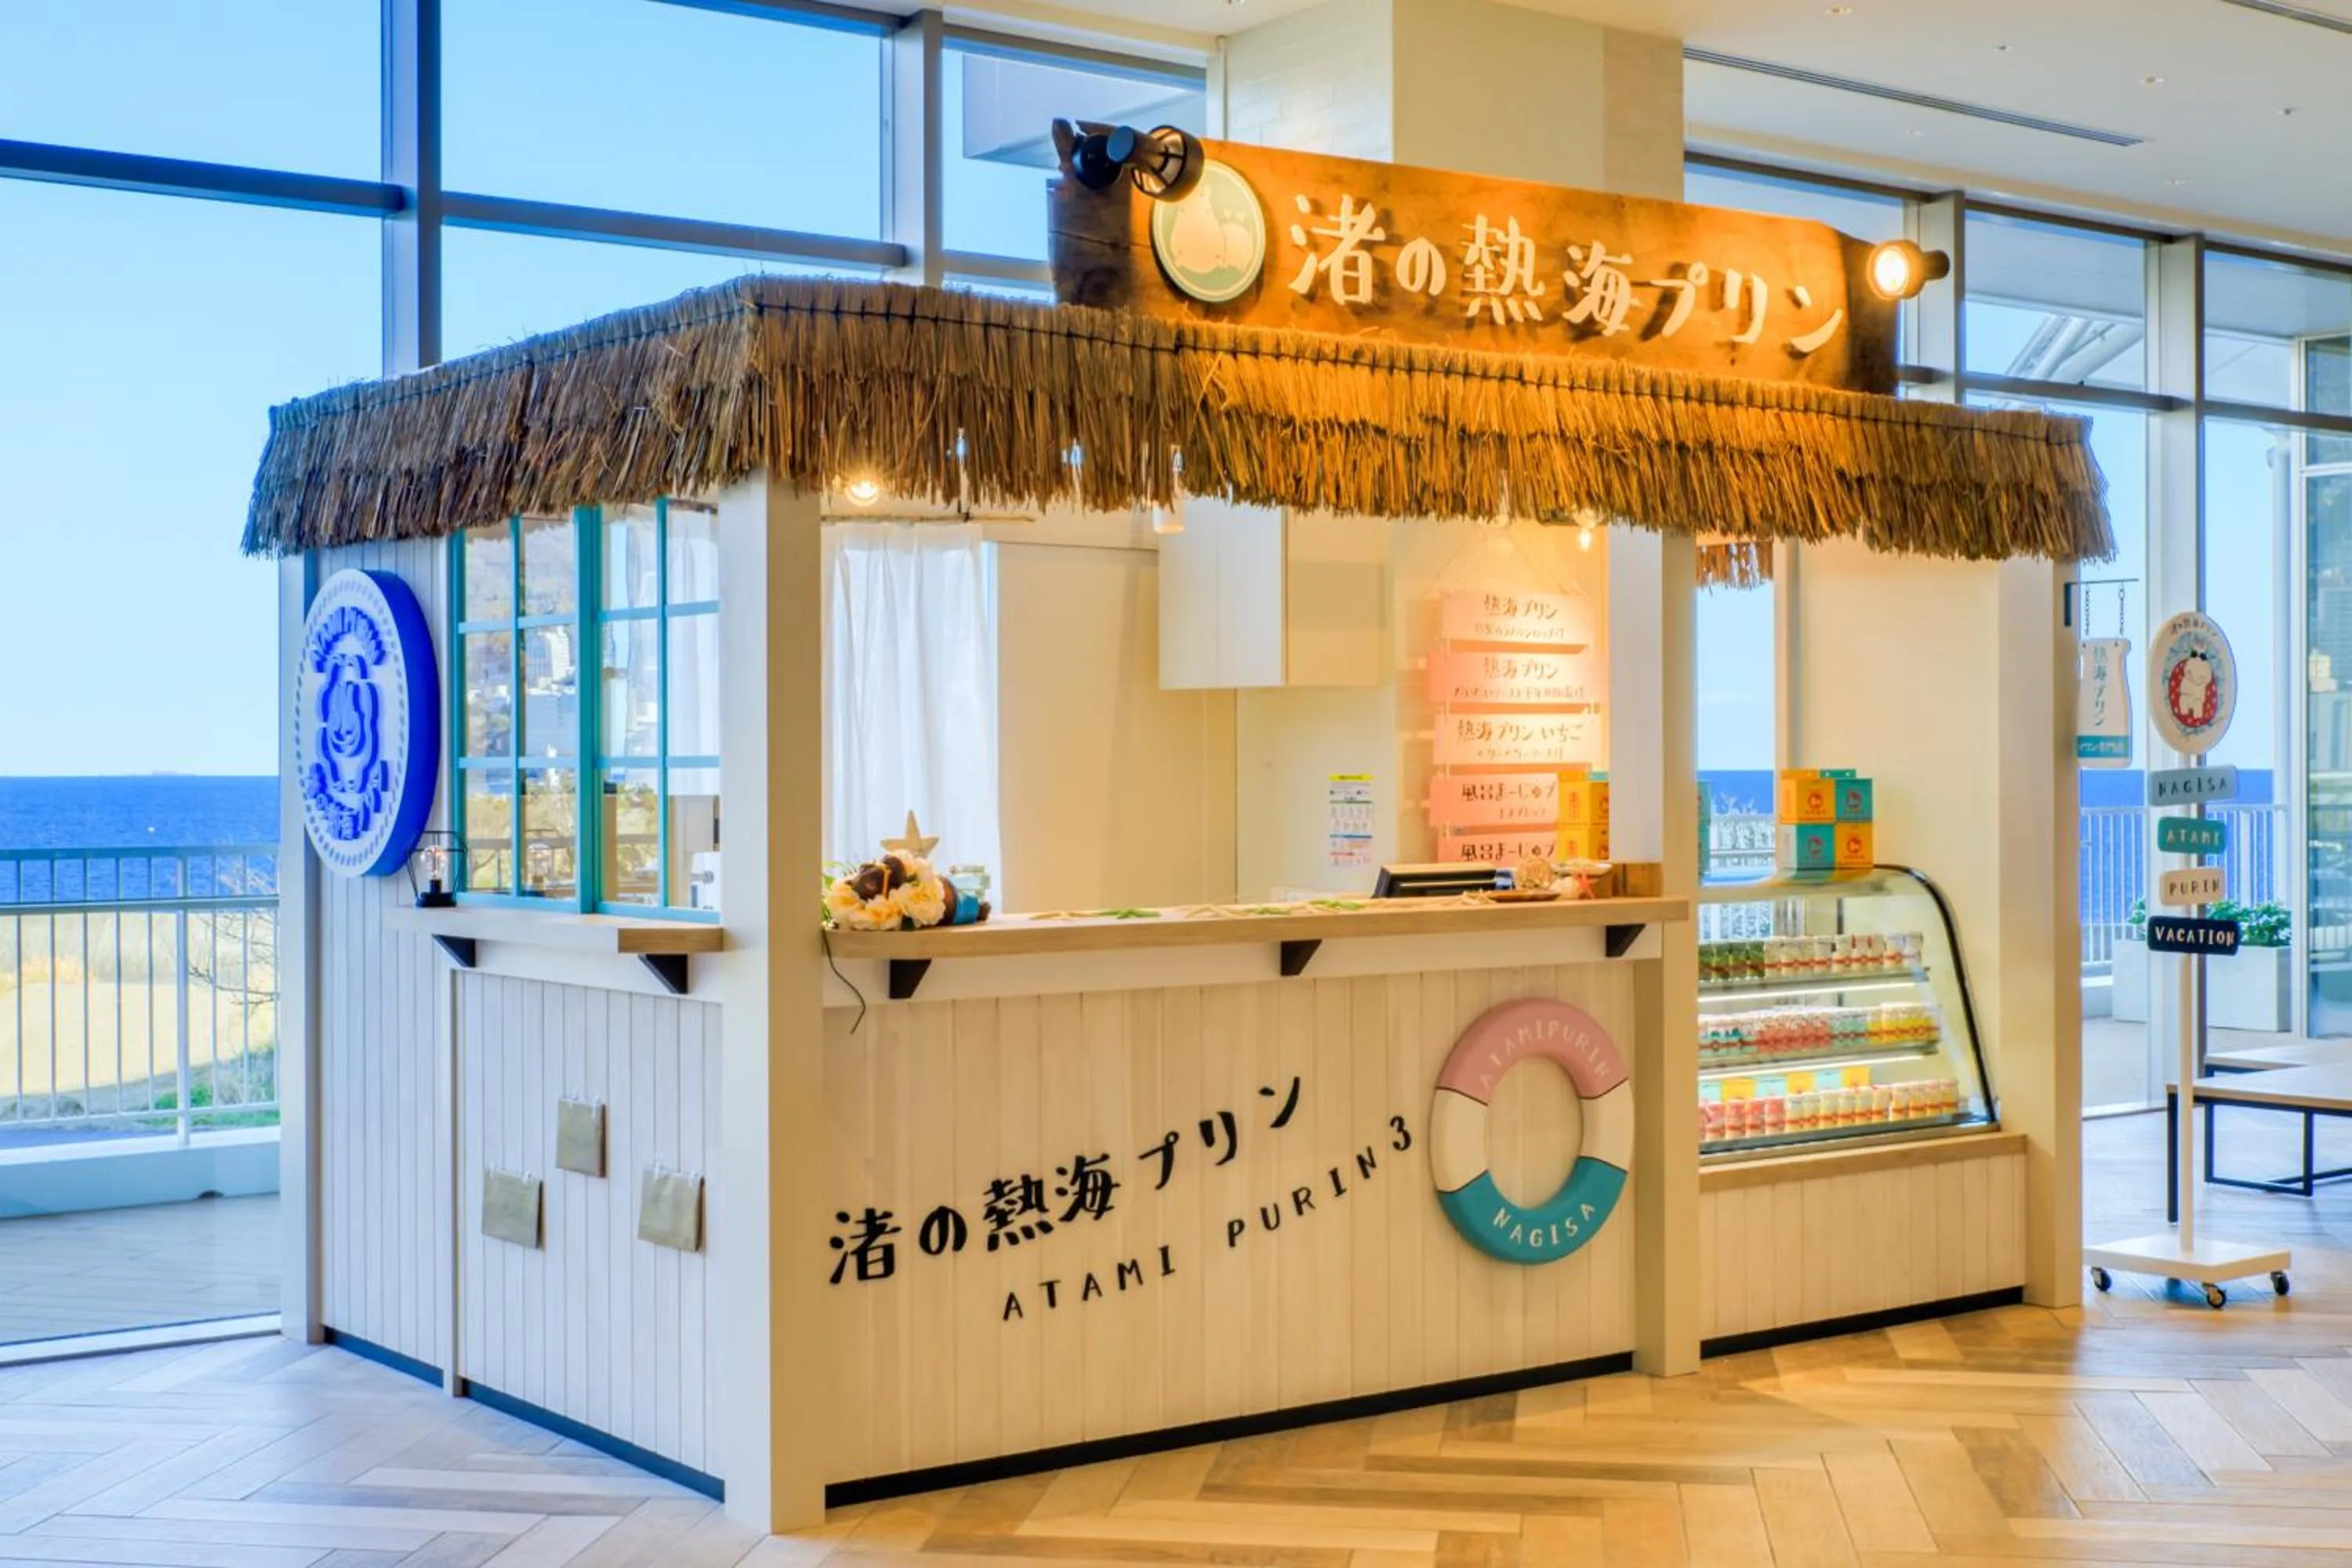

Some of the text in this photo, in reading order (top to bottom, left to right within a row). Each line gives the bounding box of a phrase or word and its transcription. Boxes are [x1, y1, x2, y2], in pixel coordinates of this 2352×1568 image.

[1288, 193, 1842, 354] 渚の熱海プリン
[2158, 776, 2227, 798] NAGISA
[2166, 828, 2220, 845] ATAMI
[2169, 877, 2220, 897] PURIN
[2155, 926, 2235, 947] VACATION
[1480, 1019, 1611, 1091] ATAMIPURIN
[829, 1076, 1301, 1285] 渚の熱海プリン
[1493, 1203, 1595, 1247] NAGISA
[1002, 1244, 1175, 1321] ATAMI
